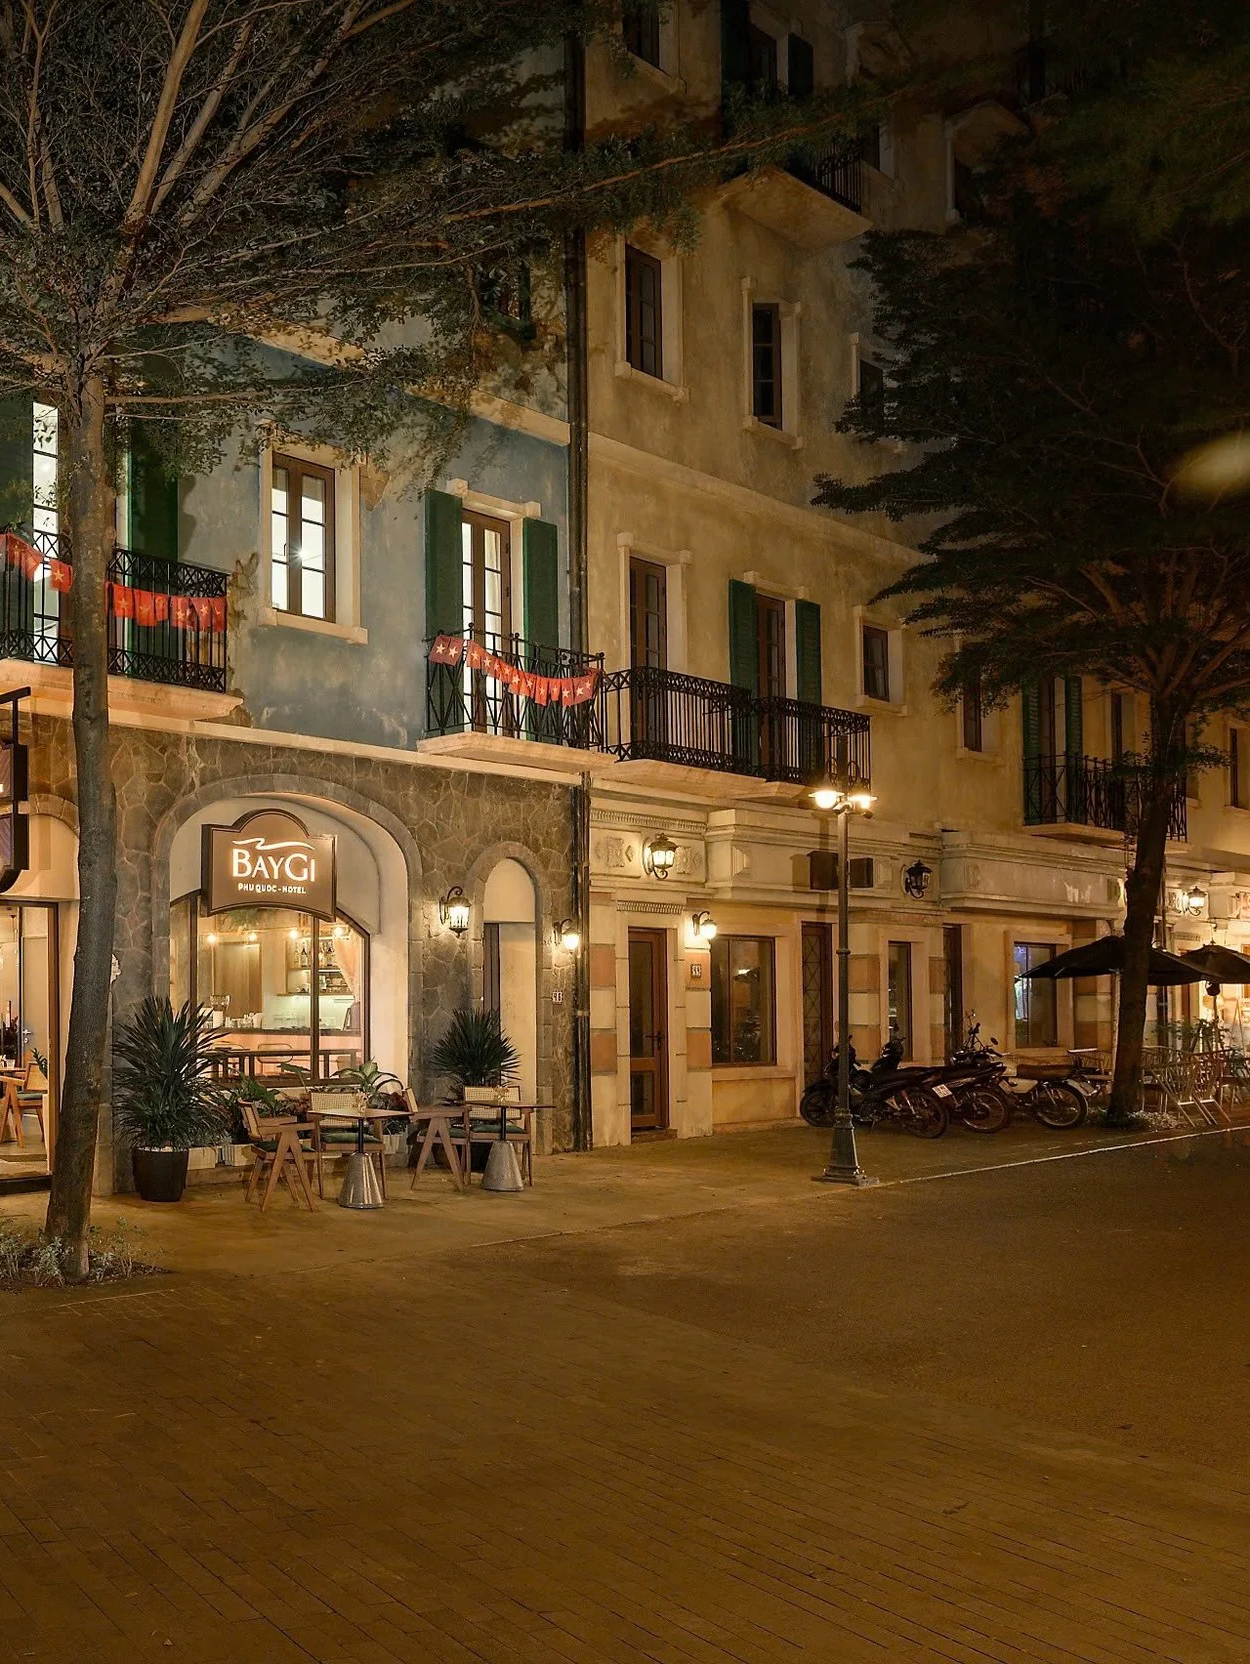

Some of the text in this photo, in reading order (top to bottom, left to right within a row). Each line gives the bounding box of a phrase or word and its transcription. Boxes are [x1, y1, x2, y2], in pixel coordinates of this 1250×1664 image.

[237, 882, 255, 892] PHU
[255, 884, 278, 894] QUOC
[282, 885, 307, 895] HOTEL
